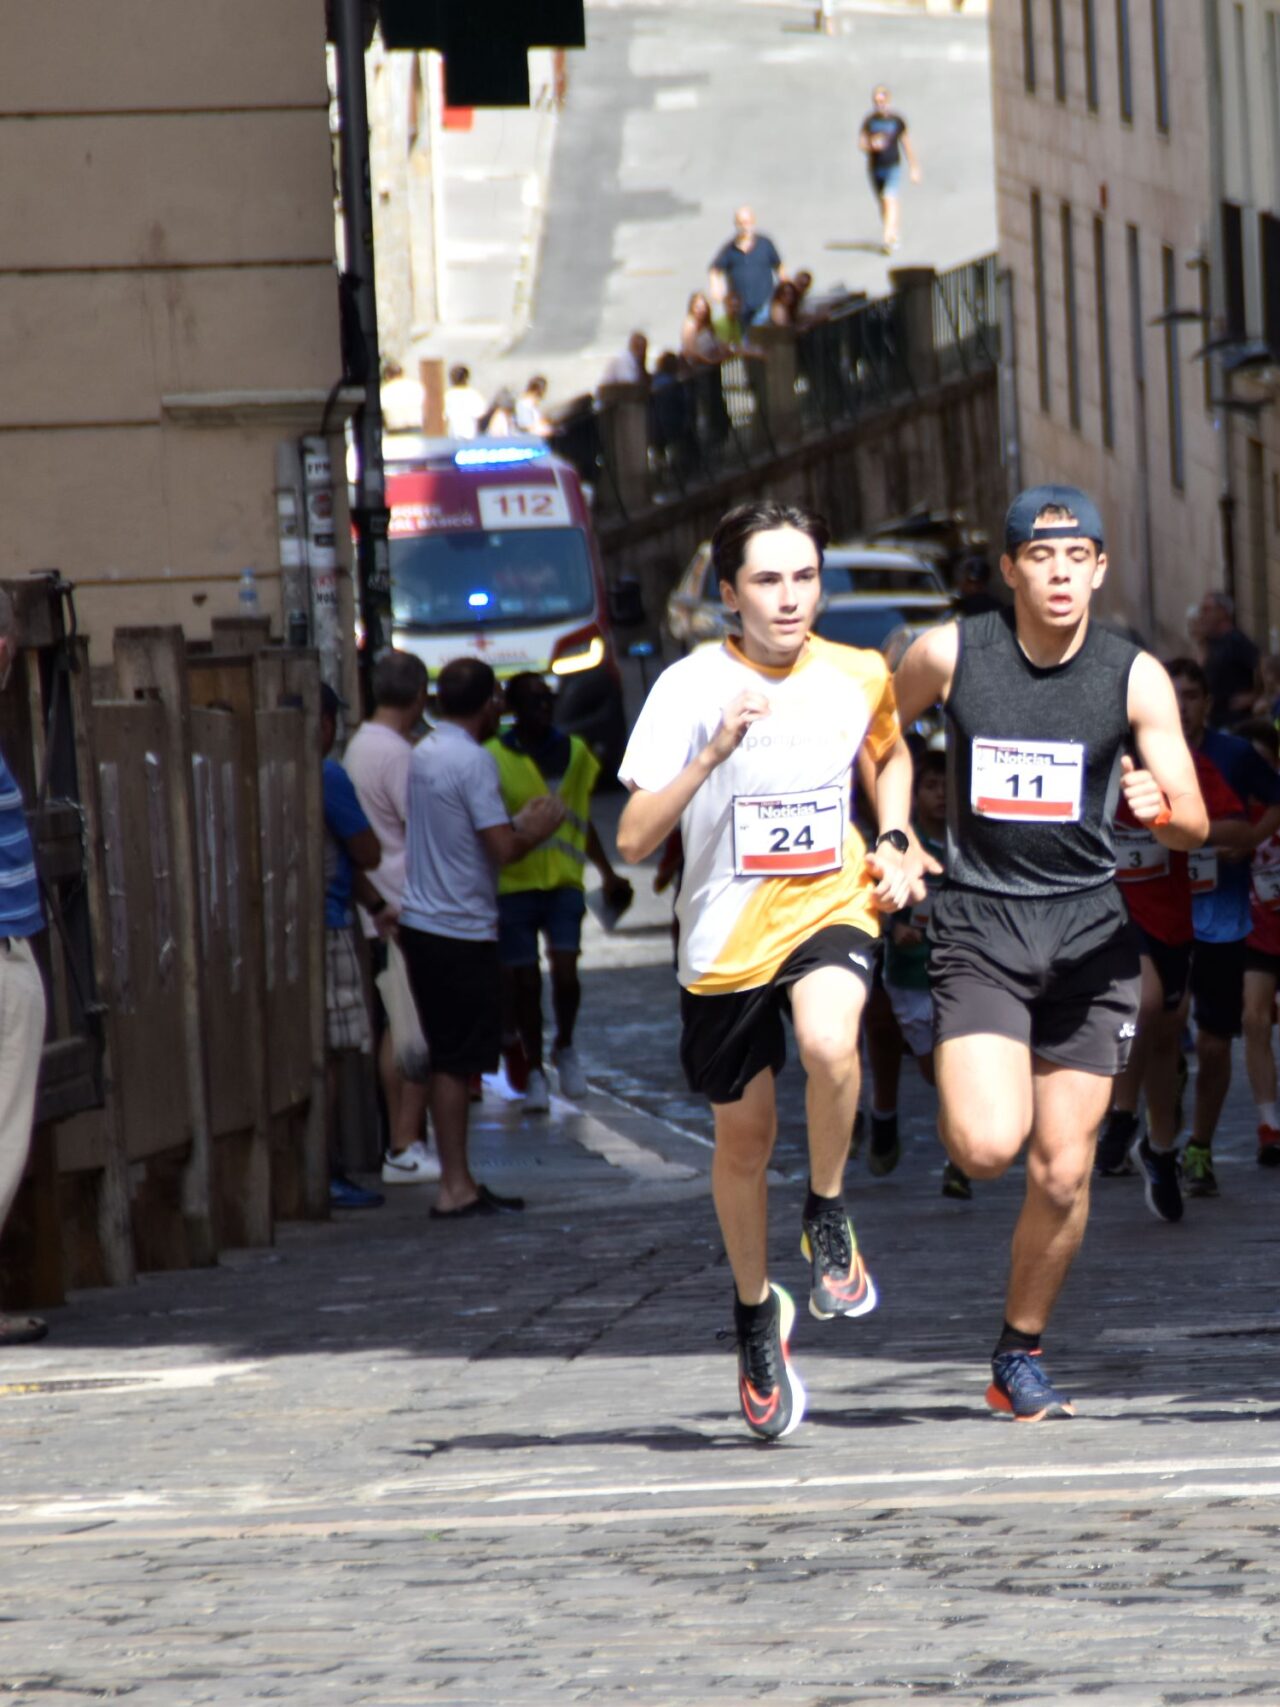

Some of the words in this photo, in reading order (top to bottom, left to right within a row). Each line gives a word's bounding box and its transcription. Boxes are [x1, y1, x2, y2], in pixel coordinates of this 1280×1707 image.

[493, 494, 555, 516] 112
[997, 751, 1053, 766] Noticias
[1005, 774, 1043, 799] 11
[761, 802, 816, 819] Noticias
[769, 825, 814, 853] 24
